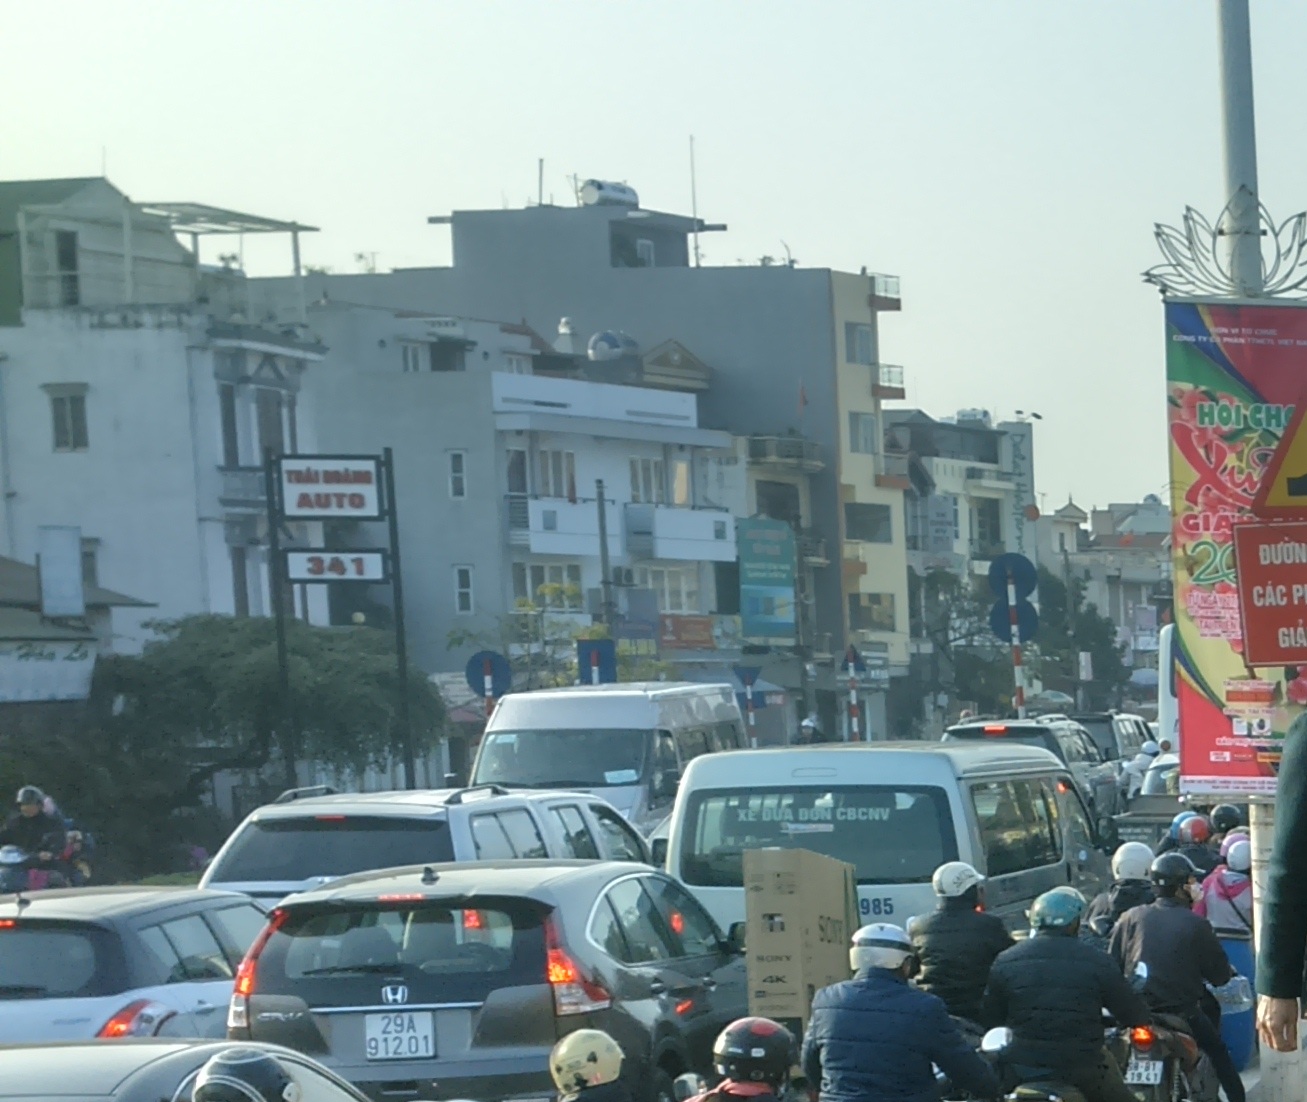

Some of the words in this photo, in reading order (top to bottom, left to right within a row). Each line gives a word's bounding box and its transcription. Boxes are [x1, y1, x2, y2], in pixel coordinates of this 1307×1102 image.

[296, 492, 366, 509] AUTO
[305, 555, 365, 577] 341
[1252, 580, 1288, 607] CÁC
[836, 807, 891, 821] CBCNV
[756, 954, 793, 963] SONY
[761, 974, 787, 984] 4K
[380, 1013, 418, 1036] 29A
[366, 1034, 431, 1057] 912.01
